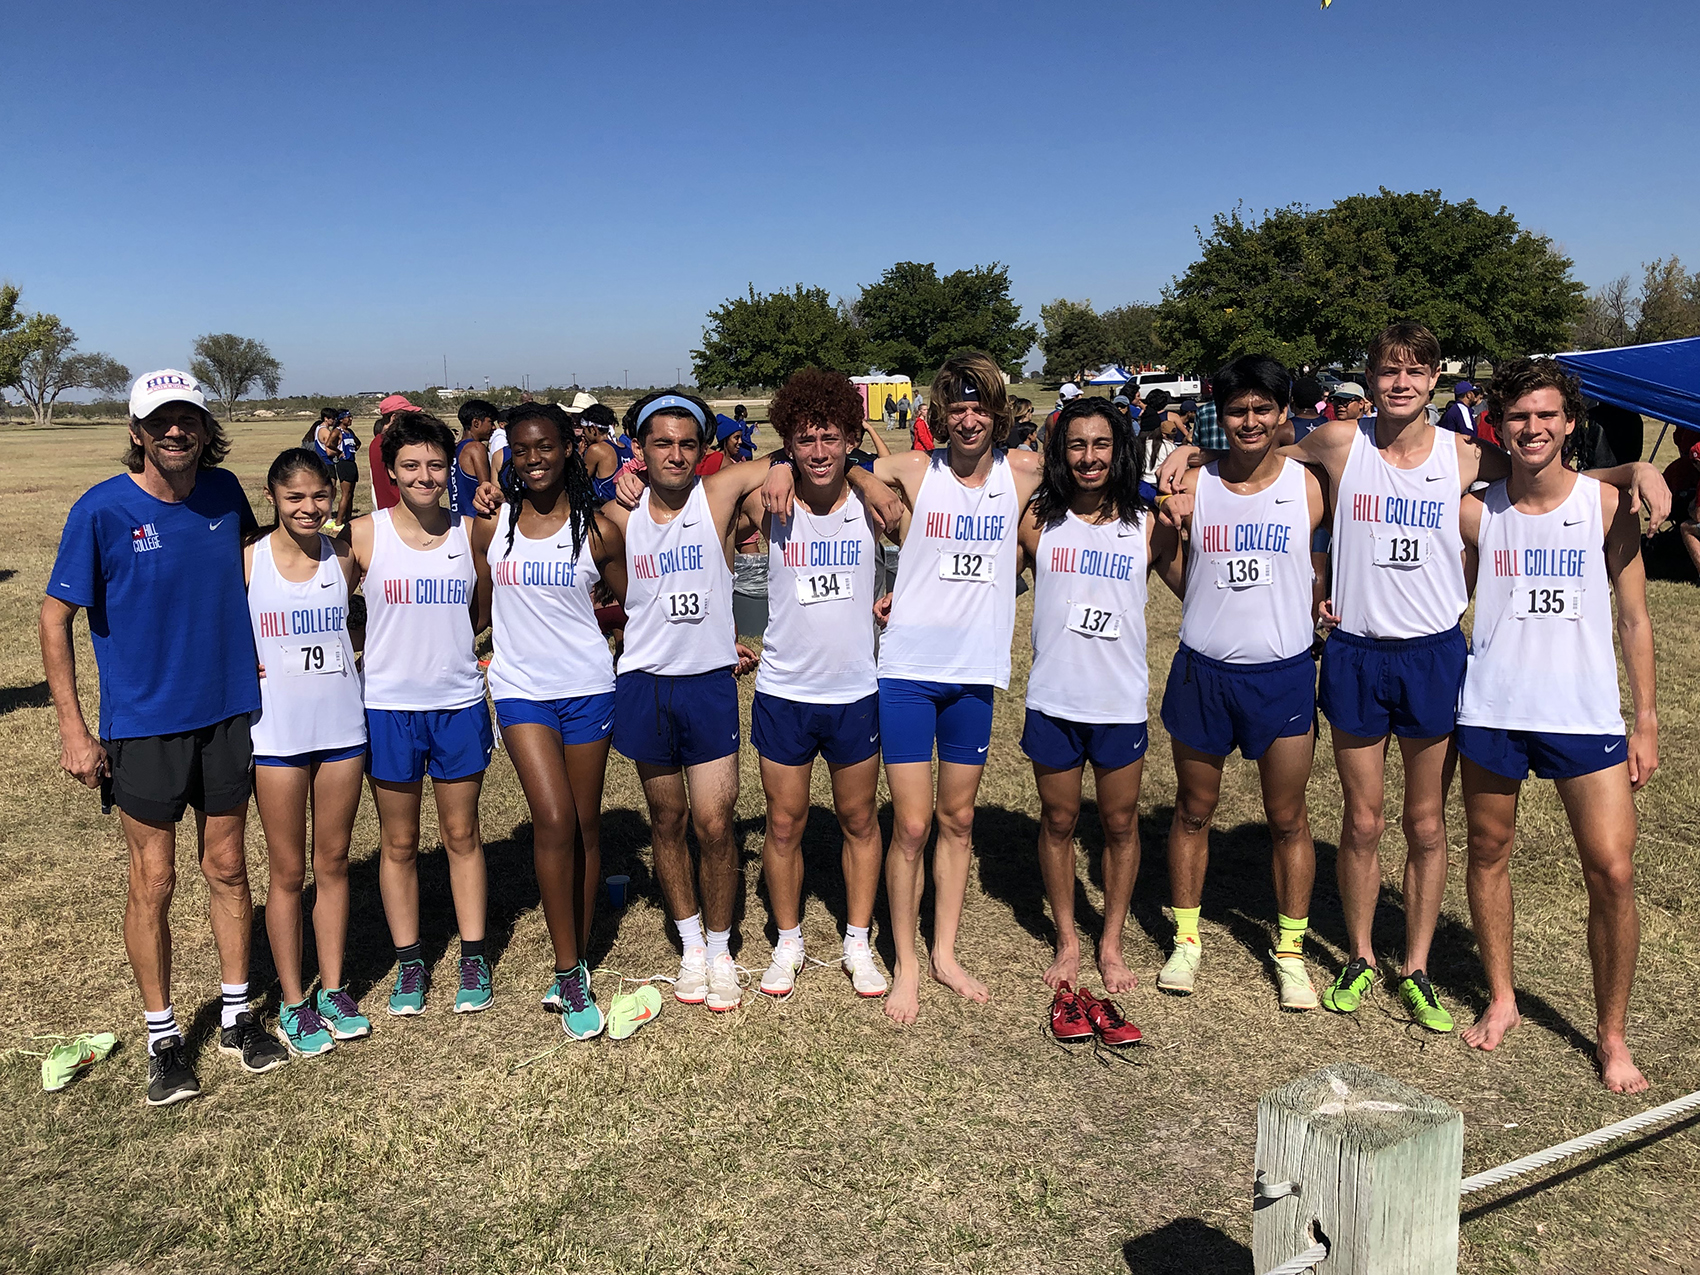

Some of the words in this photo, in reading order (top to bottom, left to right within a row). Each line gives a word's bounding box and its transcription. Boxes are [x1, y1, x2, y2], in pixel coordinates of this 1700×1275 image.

[146, 376, 190, 388] HILL
[1353, 494, 1381, 522] HILL
[1386, 496, 1445, 529] COLLEGE
[142, 522, 158, 537] HILL
[926, 512, 951, 539] HILL
[955, 515, 1005, 541] COLLEGE
[1204, 525, 1230, 552] HILL
[1235, 523, 1291, 554] COLLEGE
[132, 536, 162, 553] COLLEGE
[783, 542, 807, 567] HILL
[810, 540, 862, 566] COLLEGE
[1389, 538, 1420, 562] 131
[496, 561, 520, 586] HILL
[523, 562, 576, 588] COLLEGE
[634, 554, 659, 579] HILL
[659, 545, 704, 576] COLLEGE
[952, 554, 982, 576] 132
[1051, 548, 1076, 572] HILL
[1080, 550, 1134, 581] COLLEGE
[1226, 558, 1259, 583] 136
[1494, 550, 1520, 576] HILL
[1525, 549, 1586, 577] COLLEGE
[384, 579, 412, 604] HILL
[416, 579, 467, 604] COLLEGE
[808, 574, 840, 598] 134
[670, 593, 700, 616] 133
[1528, 589, 1564, 614] 135
[260, 612, 289, 638] HILL
[292, 607, 344, 635] COLLEGE
[1080, 608, 1112, 632] 137
[301, 646, 324, 670] 79
